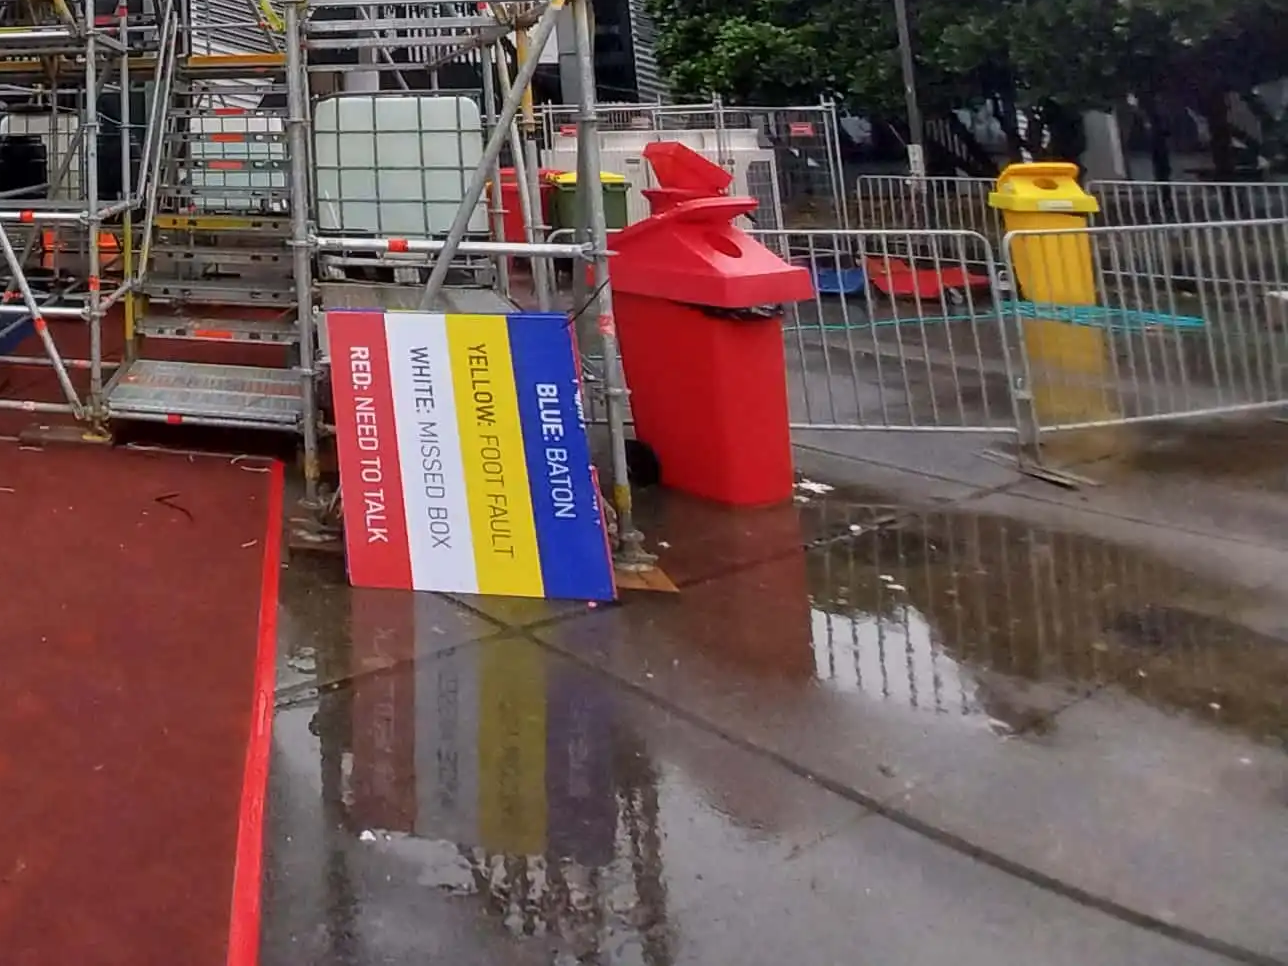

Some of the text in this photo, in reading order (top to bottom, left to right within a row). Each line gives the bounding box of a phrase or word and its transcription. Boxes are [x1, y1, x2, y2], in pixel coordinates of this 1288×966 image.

[349, 345, 389, 544] RED: NEED TO TALK
[408, 346, 452, 550] WHITE: MISSED BOX
[466, 343, 514, 559] YELLOW: FOOT FAULT
[535, 383, 576, 518] BLUE: BATON
